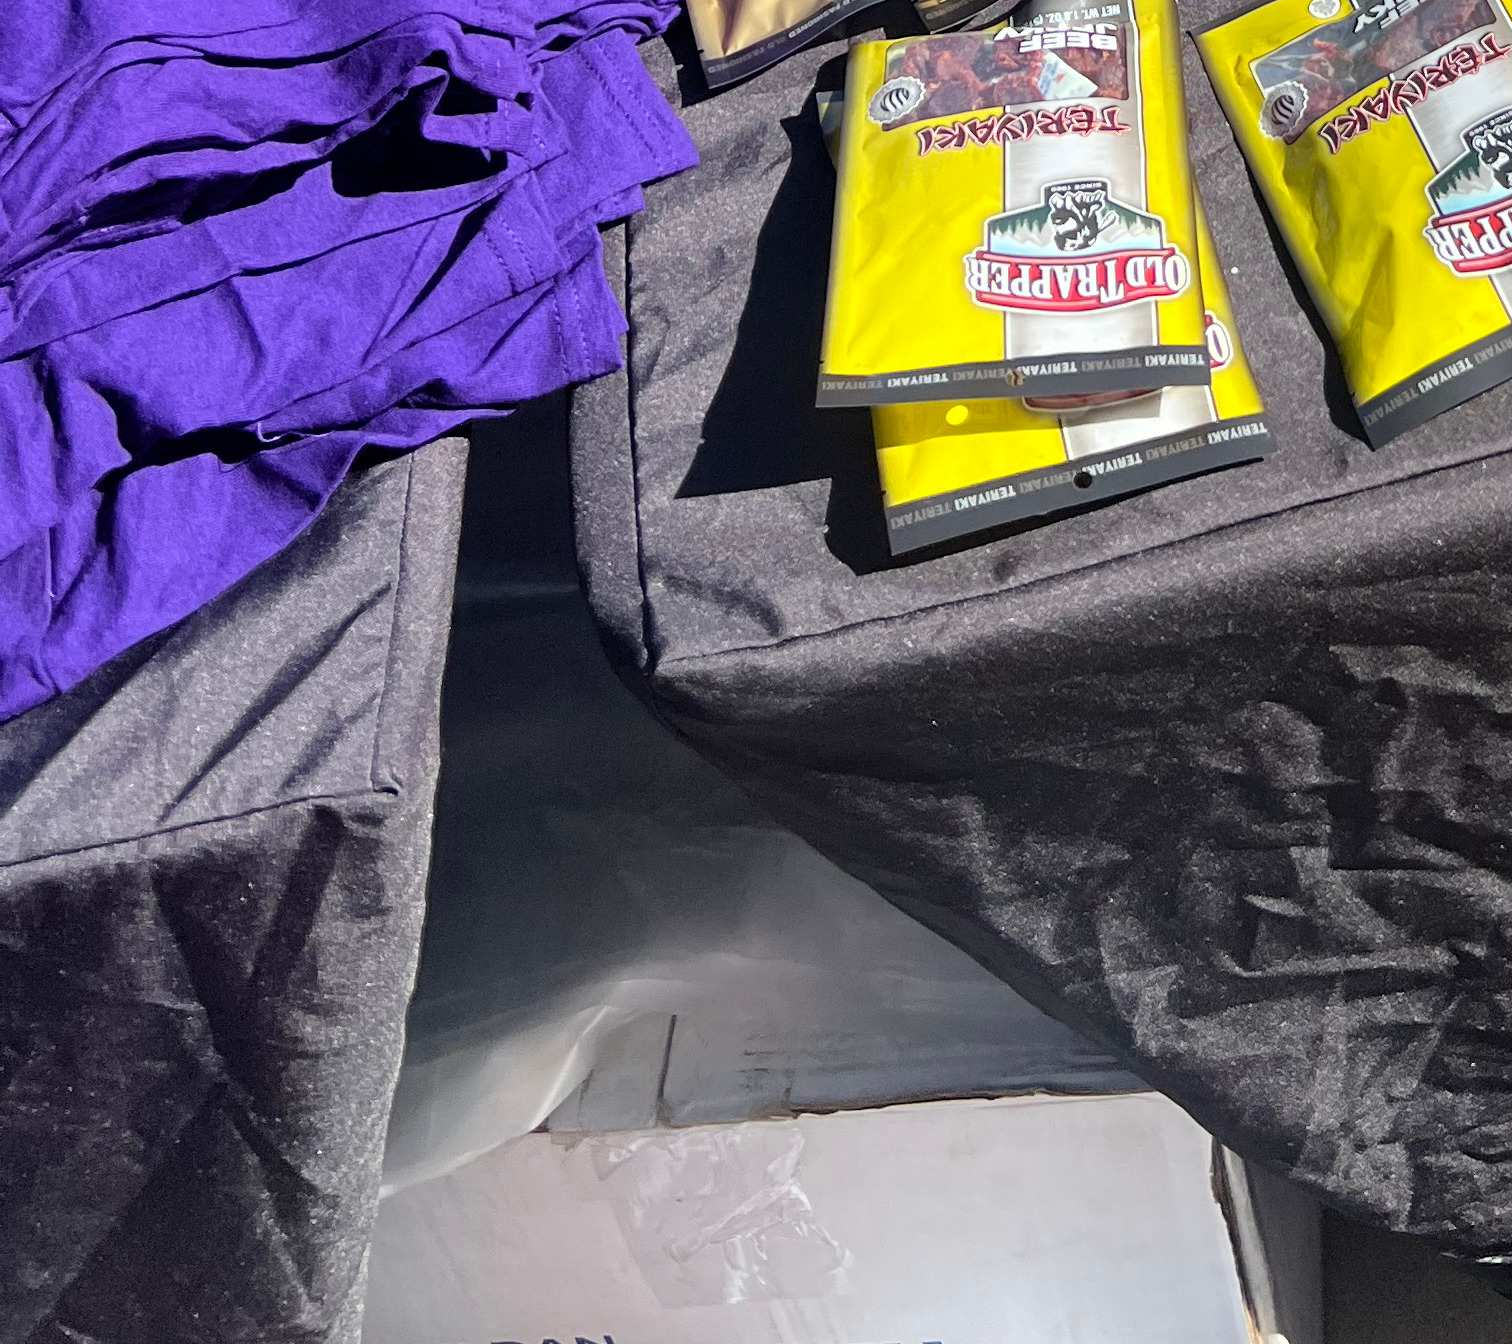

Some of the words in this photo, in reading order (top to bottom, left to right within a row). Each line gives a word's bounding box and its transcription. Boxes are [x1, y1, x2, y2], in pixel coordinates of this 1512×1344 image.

[1101, 4, 1120, 17] NET
[1019, 31, 1118, 53] BEEF
[1316, 31, 1512, 155] TERIYAKI
[915, 104, 1133, 158] TERIYAKI
[963, 257, 1127, 305] TRAPPER
[1125, 255, 1188, 293] OLD
[1143, 353, 1206, 368] TERIYAKI
[886, 371, 949, 389] TERIYAKI
[1416, 356, 1475, 395] TERIYAKI
[1206, 421, 1268, 445] TERIYAKI
[953, 484, 1017, 511] TERIYAKI
